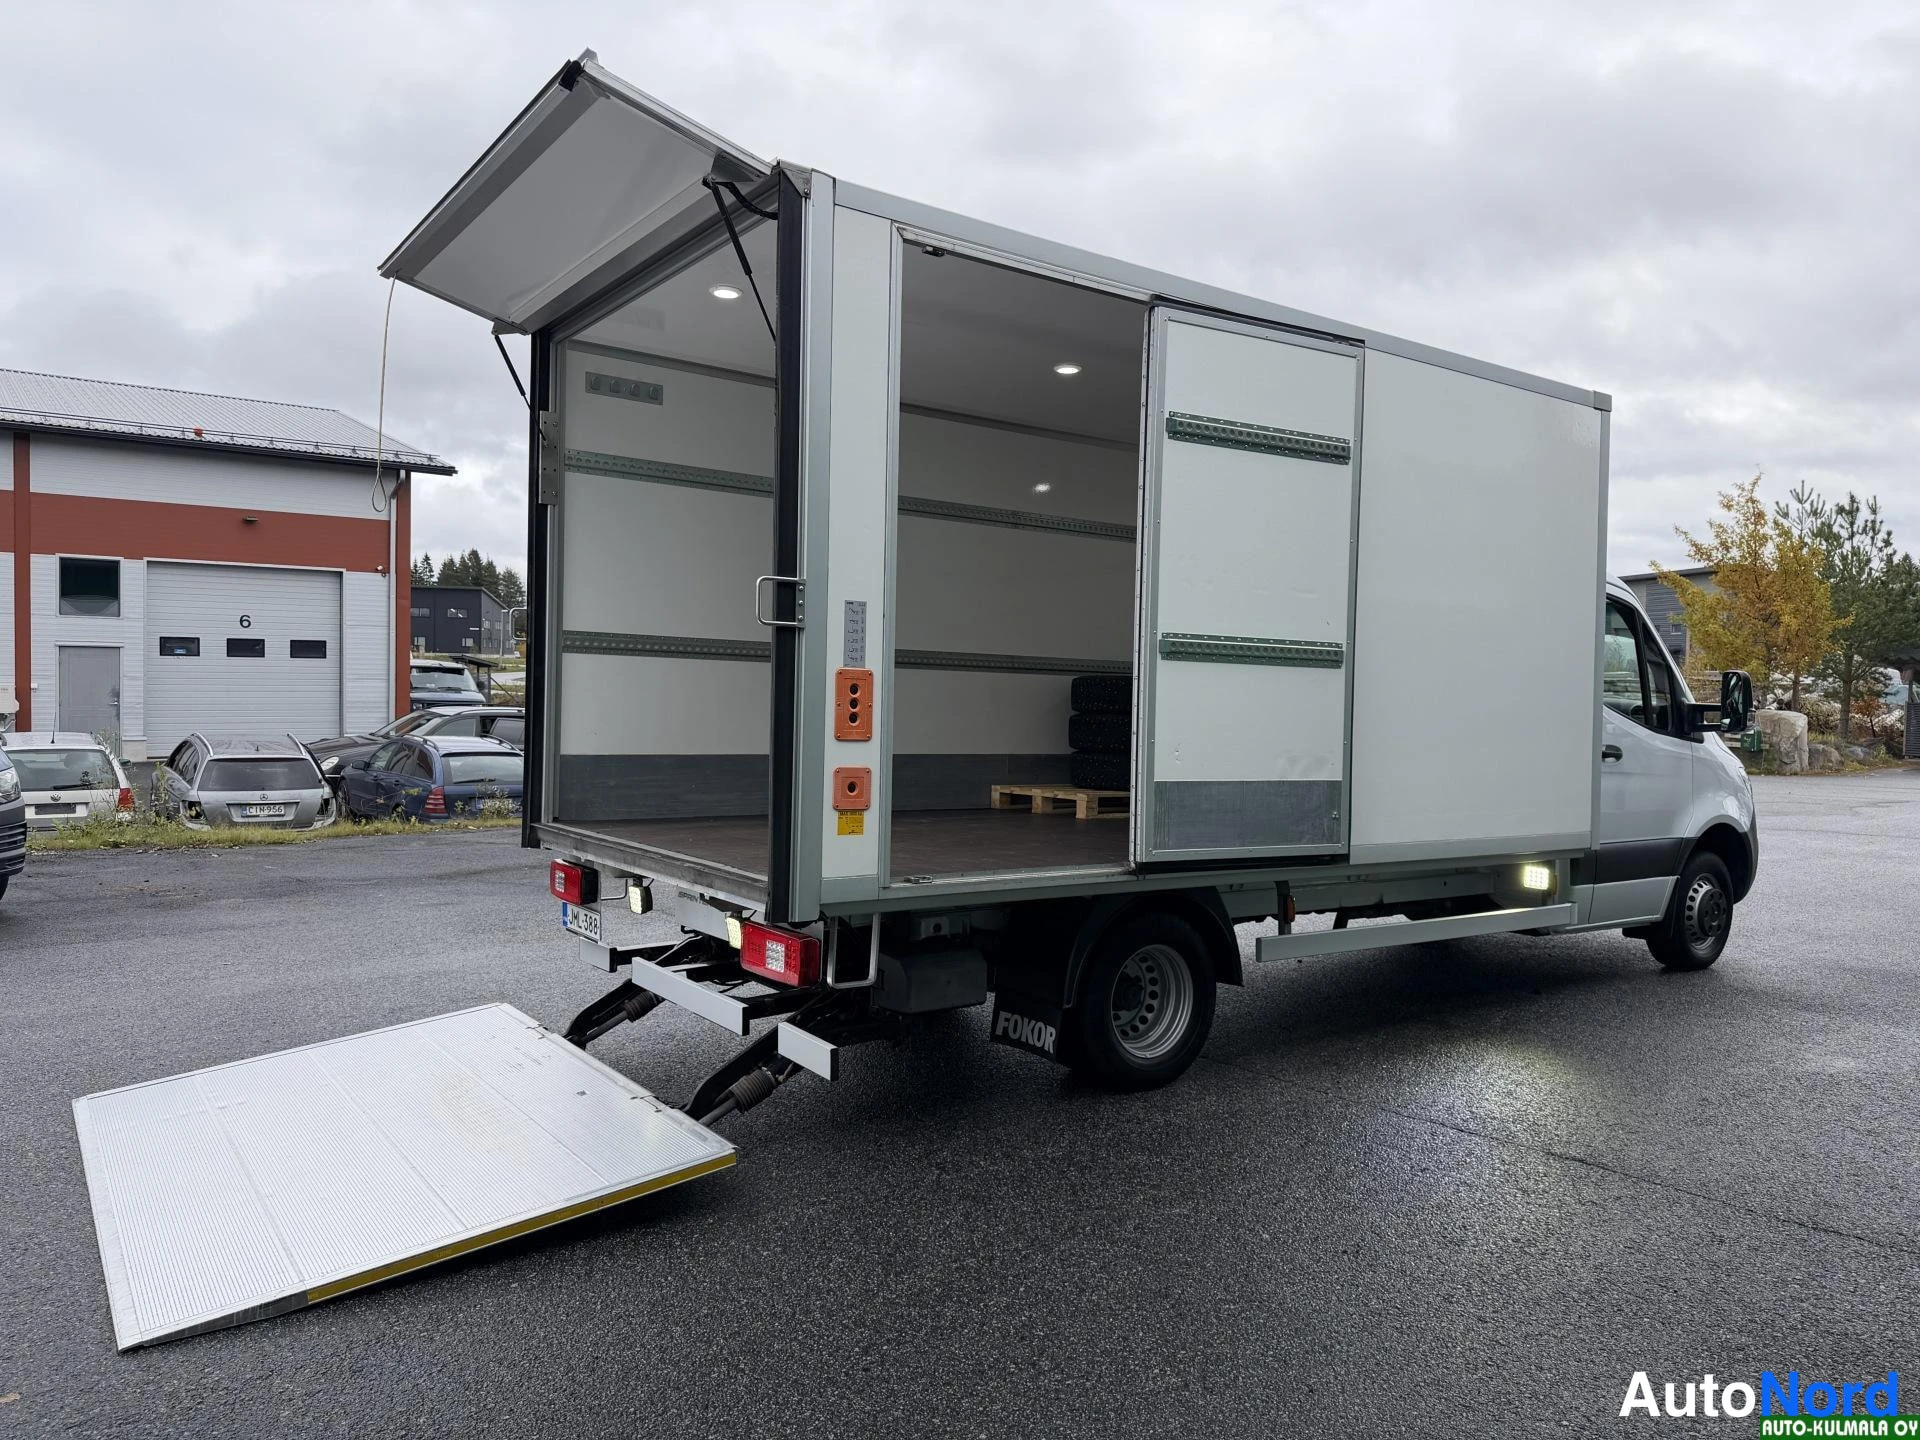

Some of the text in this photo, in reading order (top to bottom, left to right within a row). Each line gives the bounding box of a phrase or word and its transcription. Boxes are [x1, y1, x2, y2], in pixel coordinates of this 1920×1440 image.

[240, 614, 252, 629] 6
[248, 805, 284, 814] CIN-956
[568, 908, 598, 935] JML-388
[995, 1010, 1056, 1054] FOKOR
